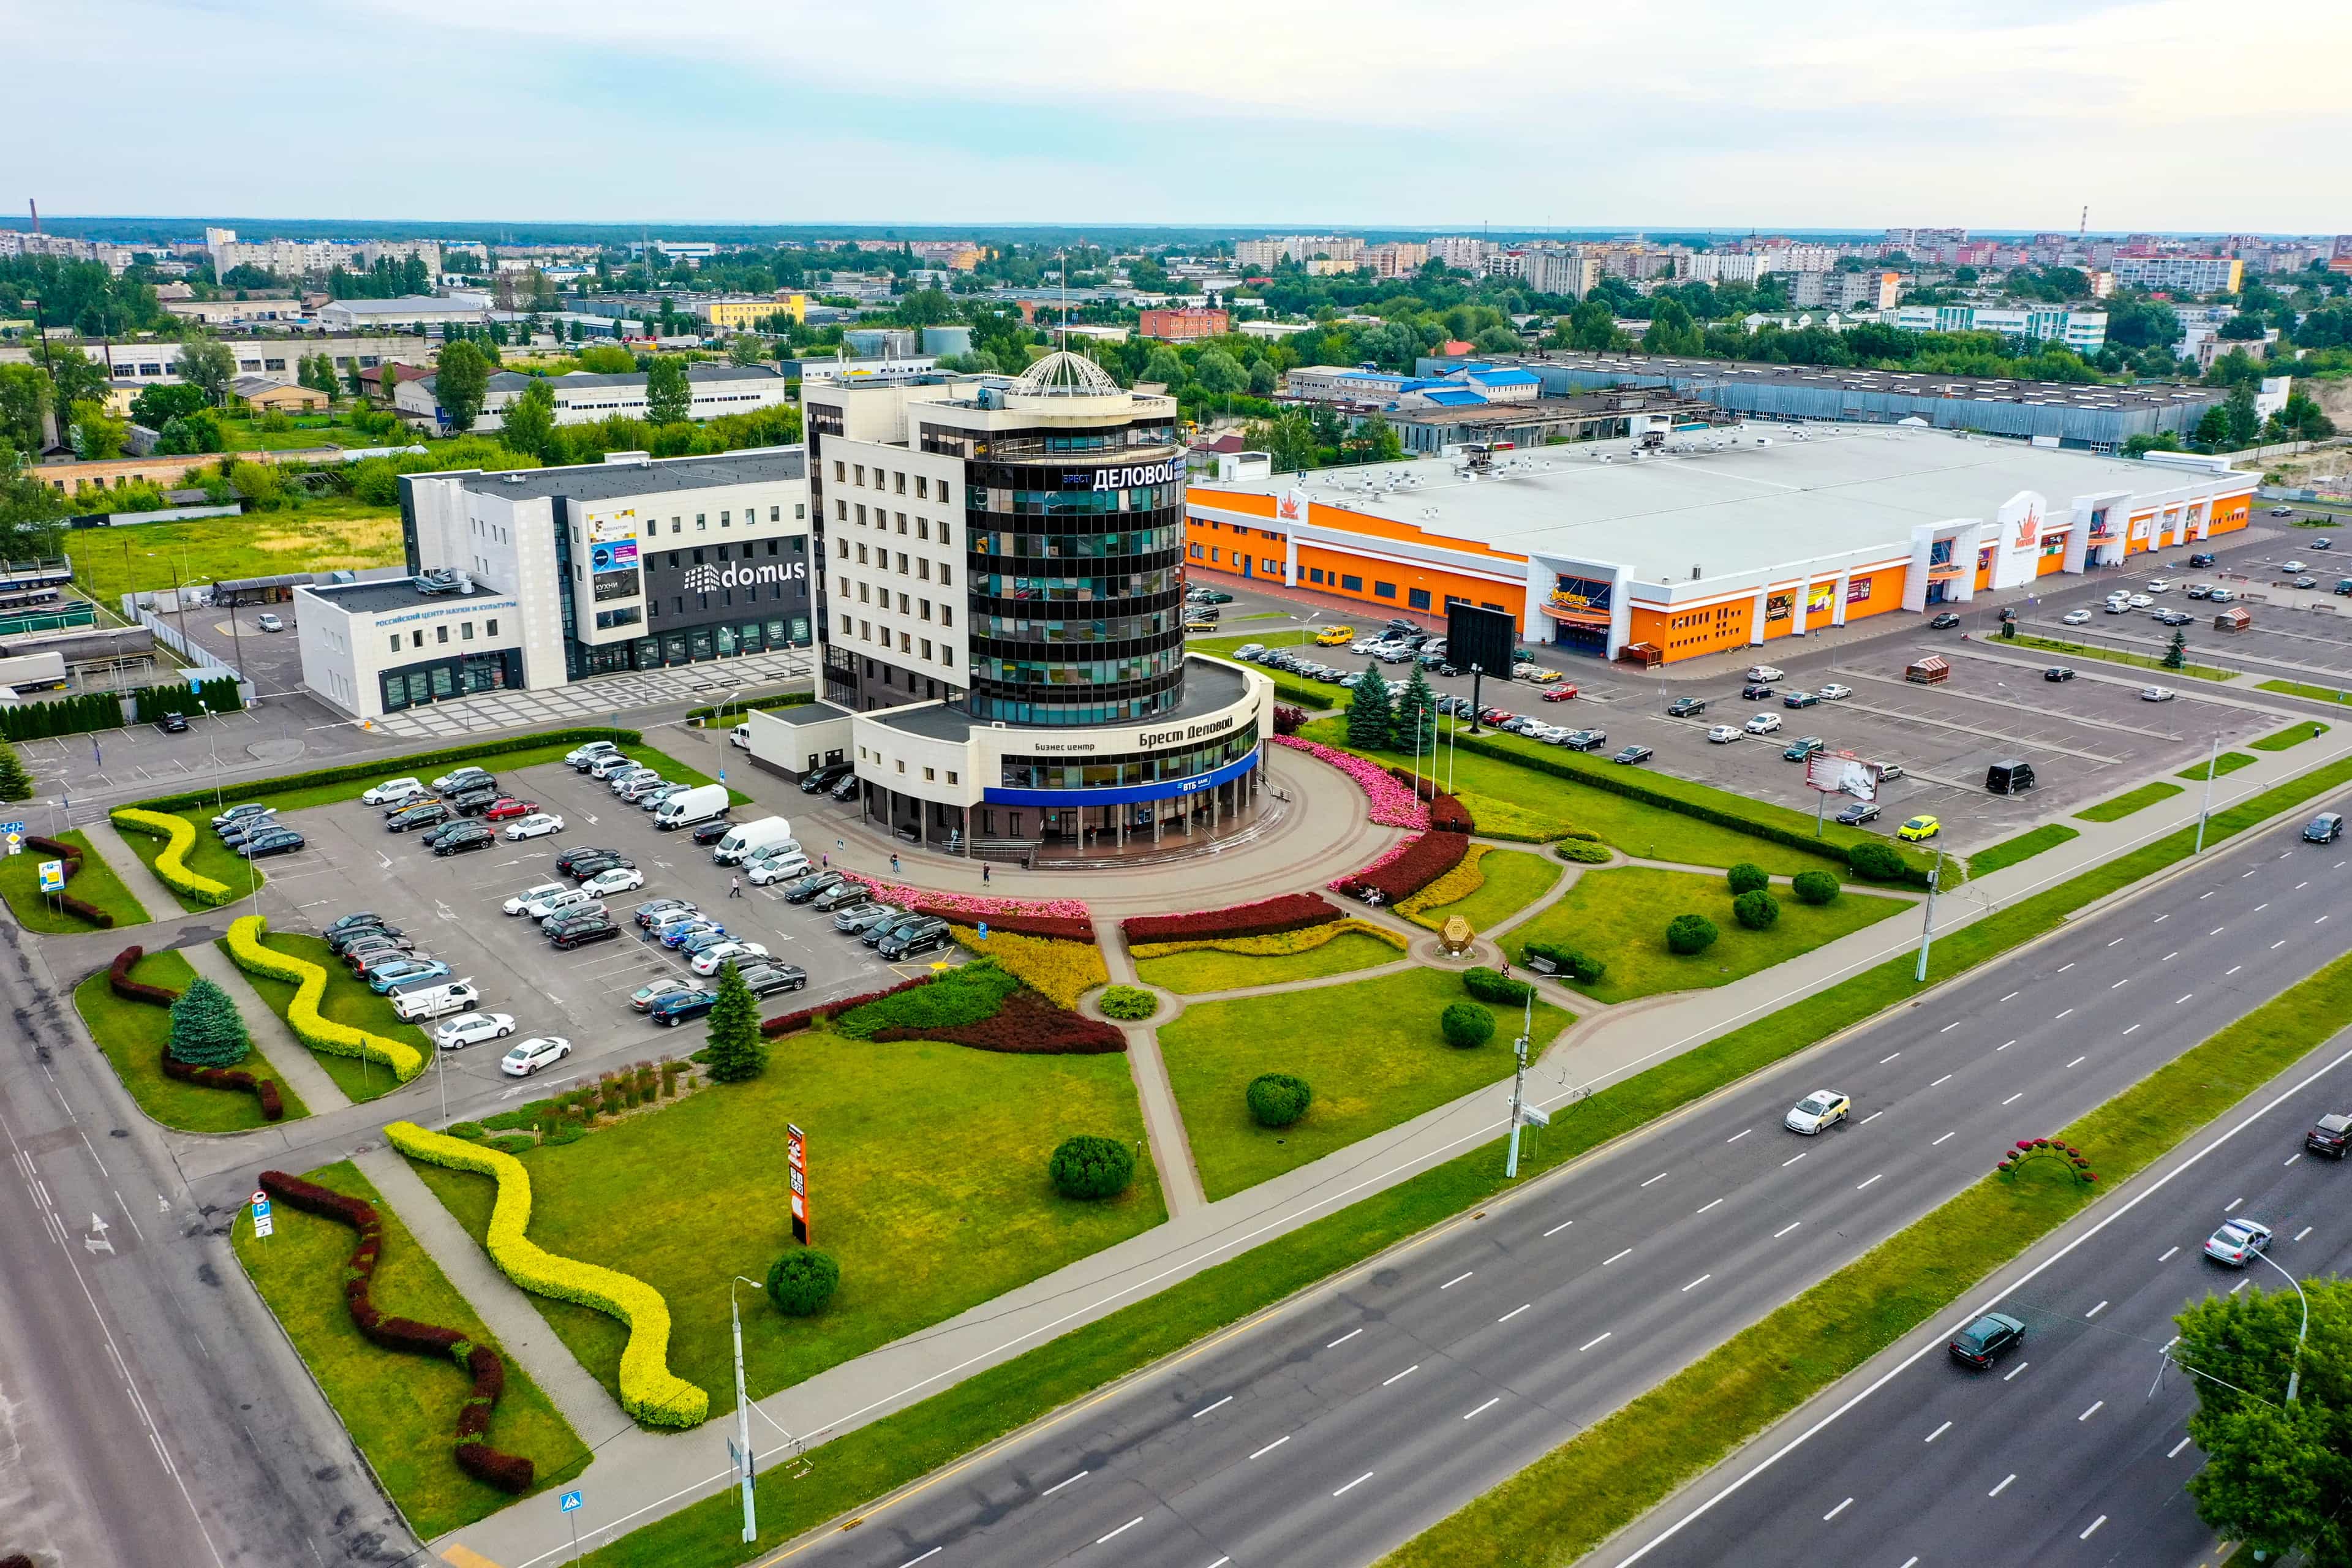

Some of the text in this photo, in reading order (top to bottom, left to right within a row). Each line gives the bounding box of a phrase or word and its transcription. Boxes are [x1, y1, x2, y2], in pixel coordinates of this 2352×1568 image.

[1093, 456, 1176, 492] ДЕЛОВОЙ
[595, 582, 618, 591] КУХНИ
[722, 560, 805, 588] domus
[375, 612, 420, 627] РОССИЙСКИЙ
[422, 609, 444, 619] ЦЕНТР
[479, 601, 517, 611] КУЛЬТУРЫ
[1139, 715, 1233, 748] Брест Деловой
[1183, 782, 1196, 791] ВТБ
[257, 1203, 265, 1215] P
